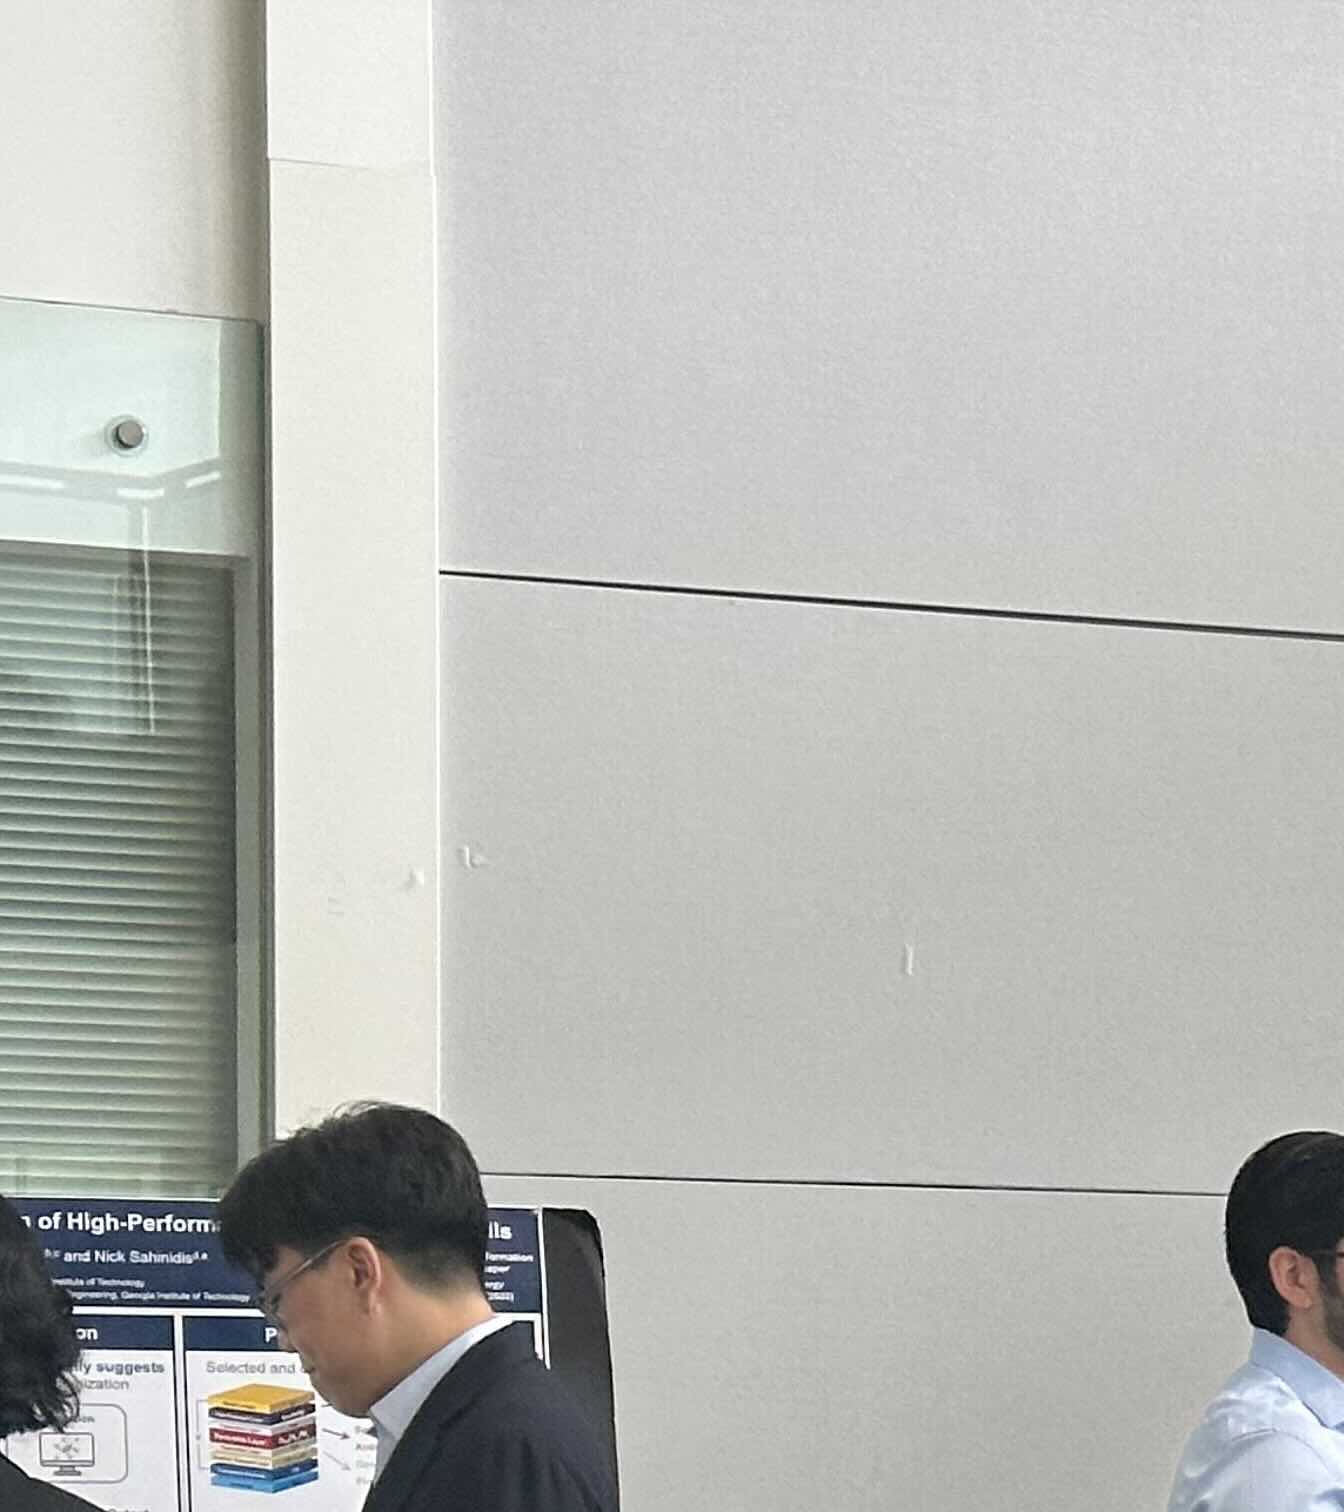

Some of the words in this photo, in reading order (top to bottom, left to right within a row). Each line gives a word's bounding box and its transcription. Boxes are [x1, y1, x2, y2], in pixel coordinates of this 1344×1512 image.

[38, 1213, 61, 1231] of
[63, 1249, 91, 1263] and
[94, 1249, 126, 1263] Nick
[97, 1278, 146, 1289] Technology
[203, 1293, 250, 1303] Technology
[96, 1361, 166, 1375] suggests
[206, 1360, 266, 1374] Selected
[270, 1361, 296, 1374] and
